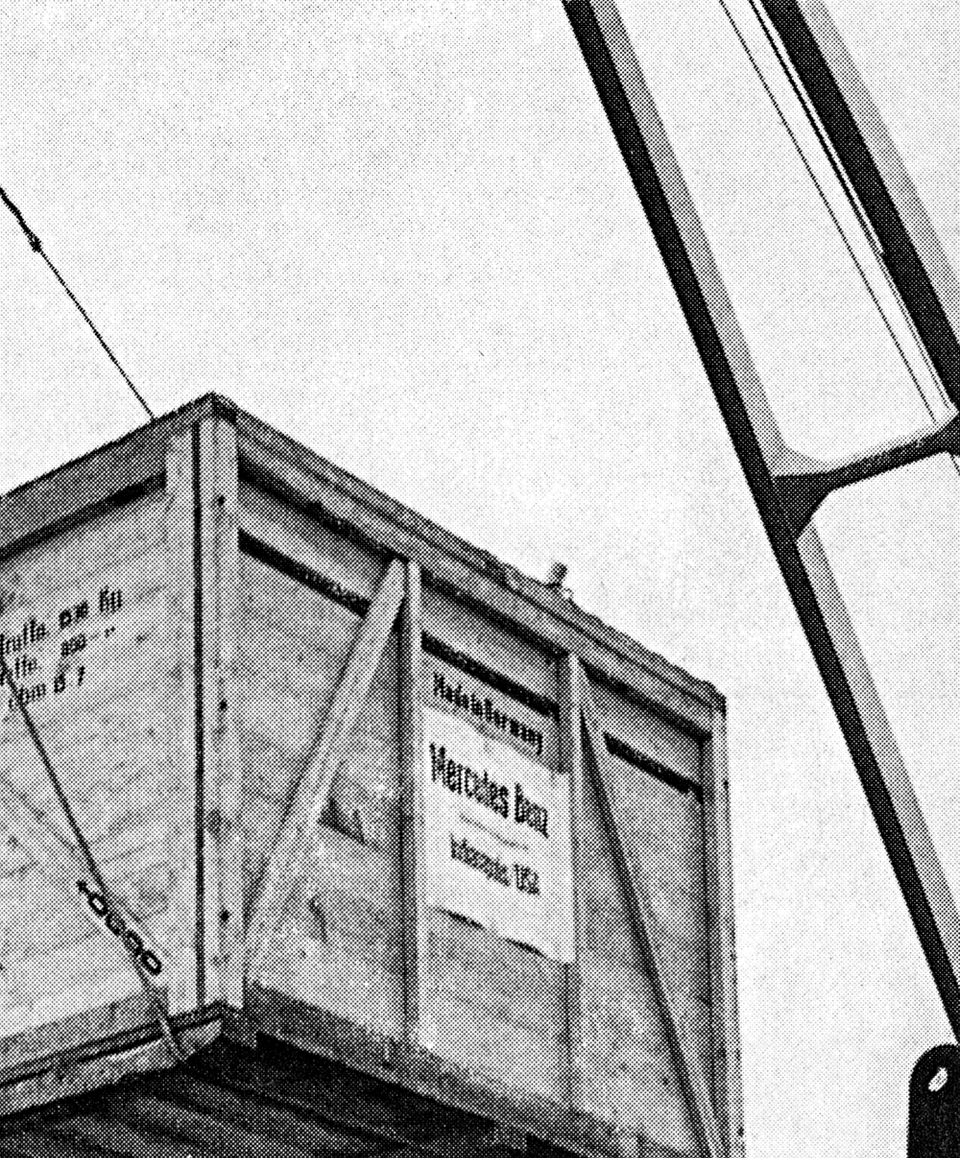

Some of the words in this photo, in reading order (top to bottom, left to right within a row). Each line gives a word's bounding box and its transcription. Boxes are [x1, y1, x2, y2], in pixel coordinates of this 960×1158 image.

[432, 672, 468, 711] Made
[483, 697, 543, 757] Germany
[429, 742, 510, 820] Mercedes
[515, 782, 550, 840] Benz
